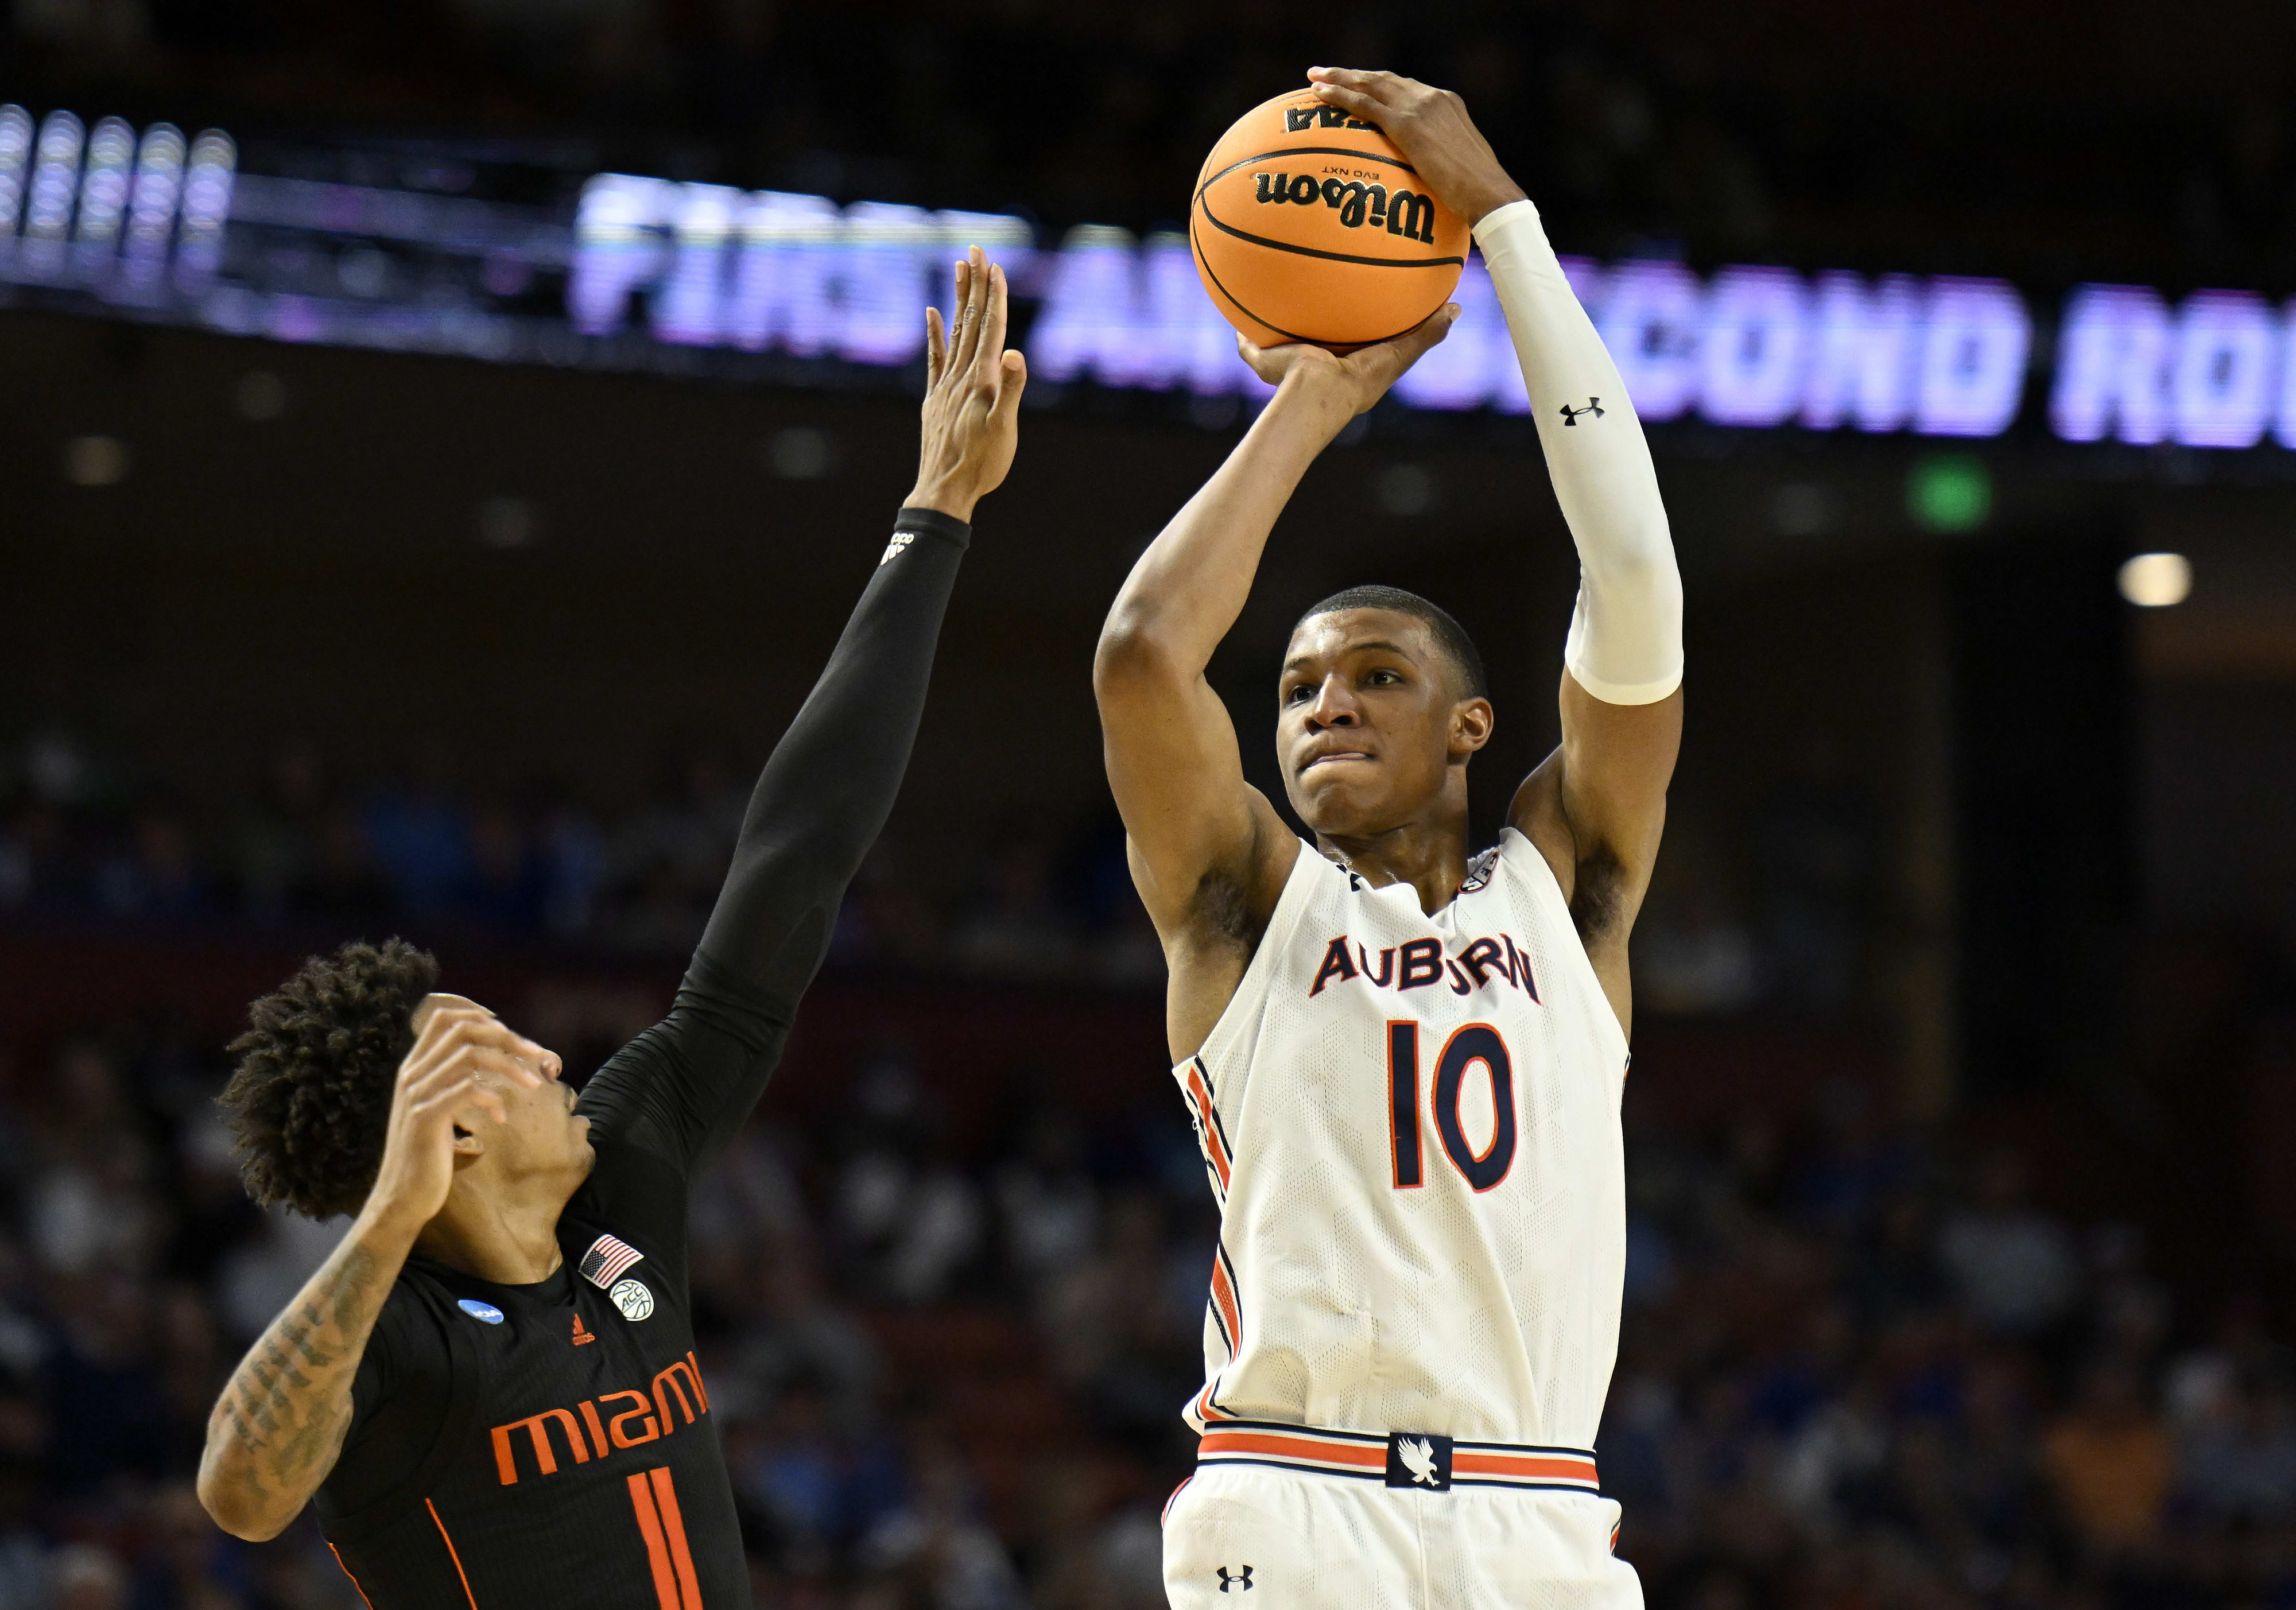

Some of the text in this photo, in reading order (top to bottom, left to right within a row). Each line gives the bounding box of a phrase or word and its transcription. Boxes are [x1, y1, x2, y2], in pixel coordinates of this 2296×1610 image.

[1284, 106, 1386, 136] AA
[1255, 172, 1435, 245] Wilson
[1321, 166, 1379, 180] EVO NXT
[1309, 933, 1542, 1006] AUBURN
[1387, 1019, 1517, 1194] 10
[621, 1285, 644, 1312] ACC
[627, 1467, 703, 1610] 11
